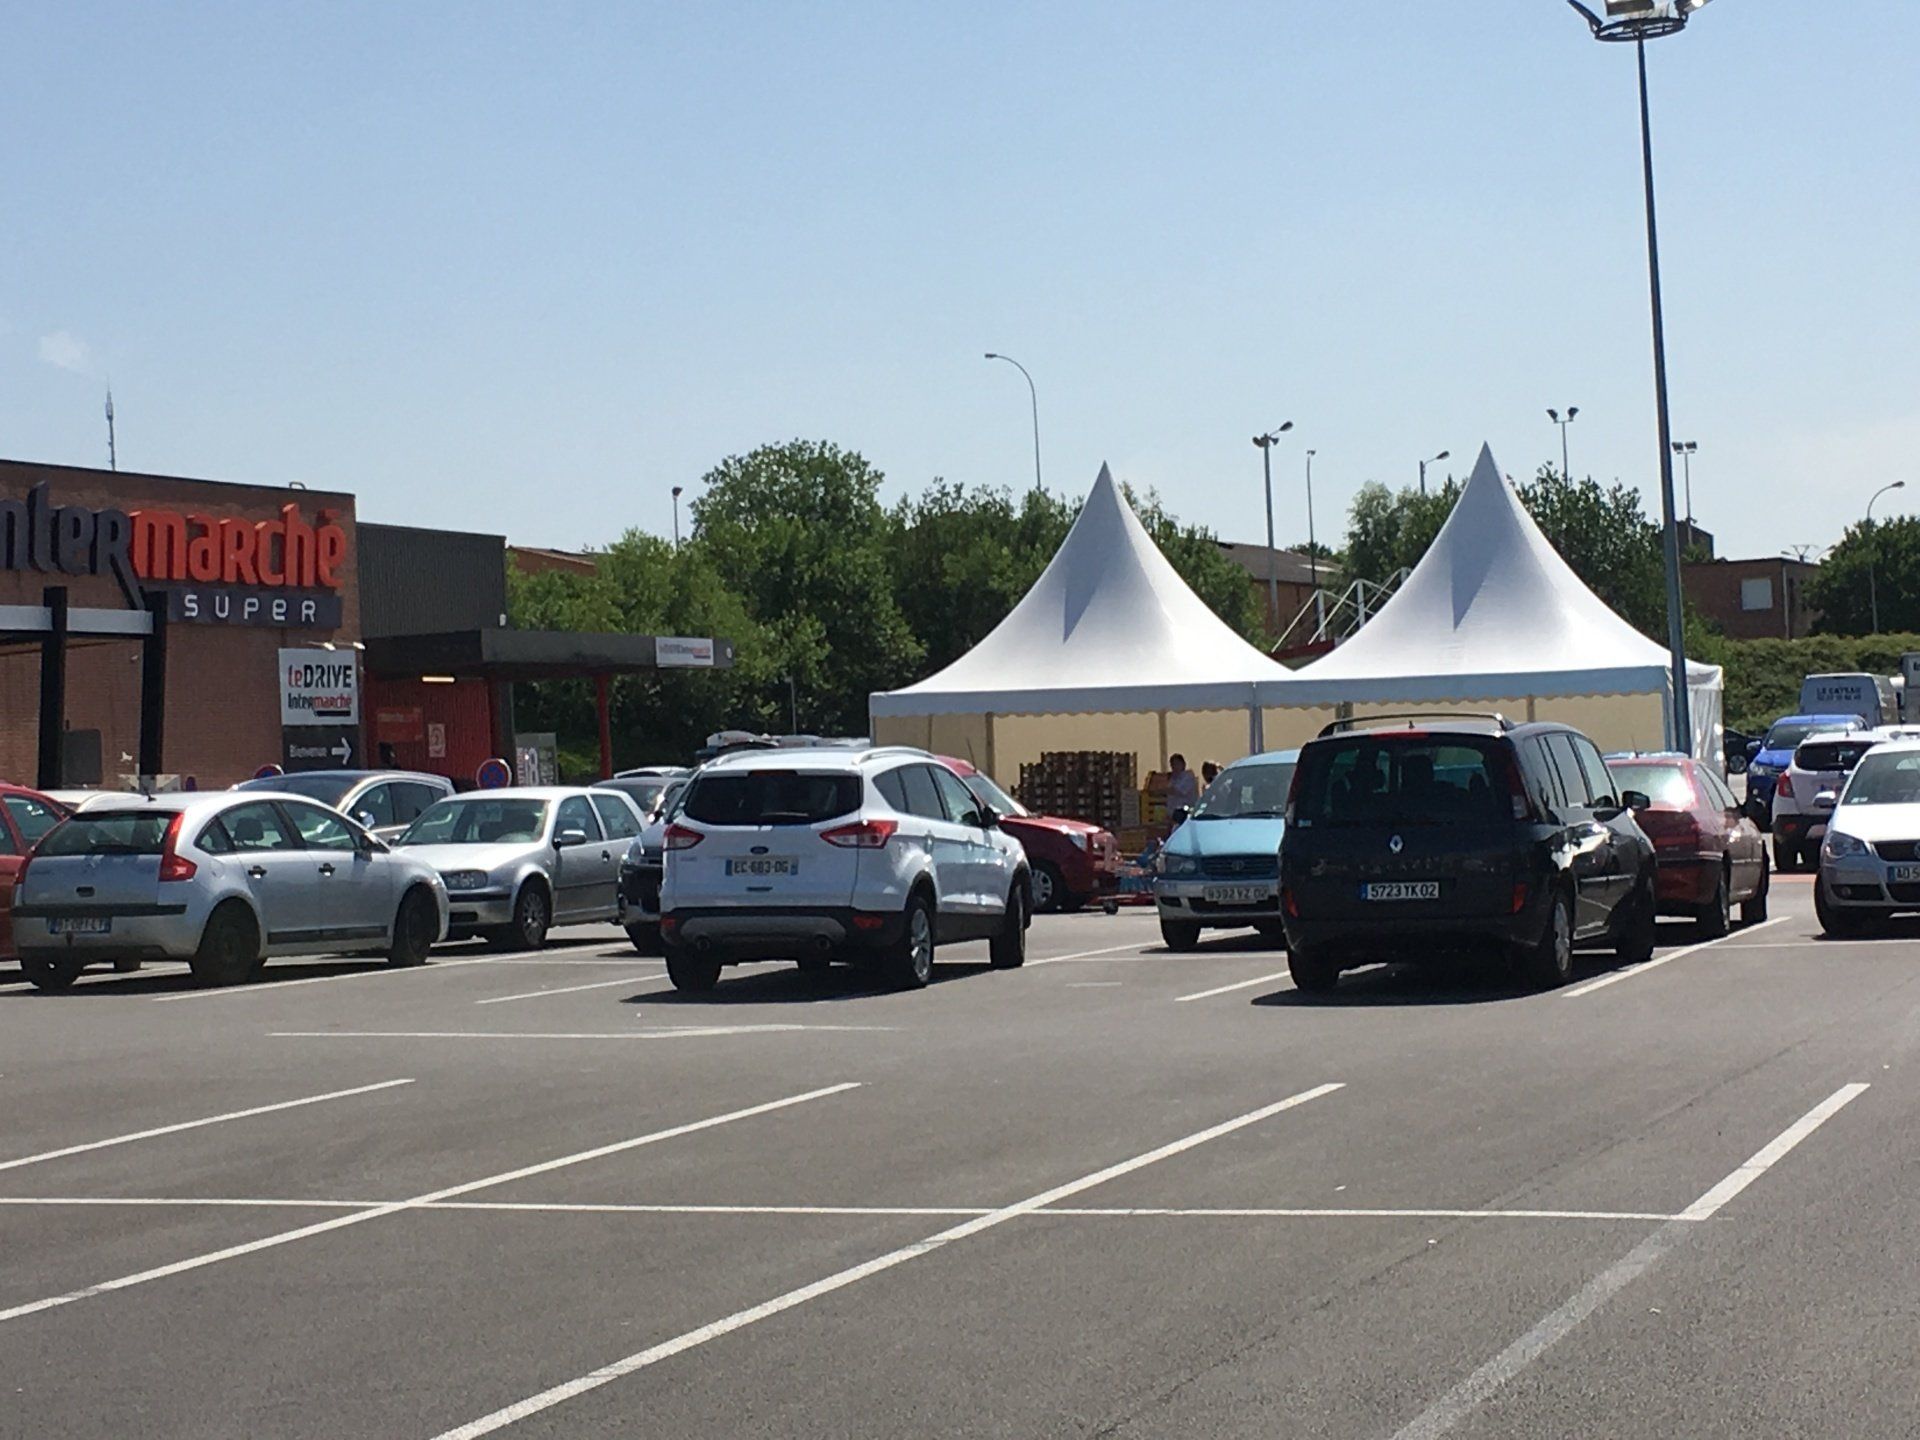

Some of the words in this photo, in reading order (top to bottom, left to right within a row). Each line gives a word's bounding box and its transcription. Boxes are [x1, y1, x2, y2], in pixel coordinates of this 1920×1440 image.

[1371, 884, 1402, 898] 5723
[1403, 884, 1419, 897] YK
[1420, 883, 1437, 897] 02
